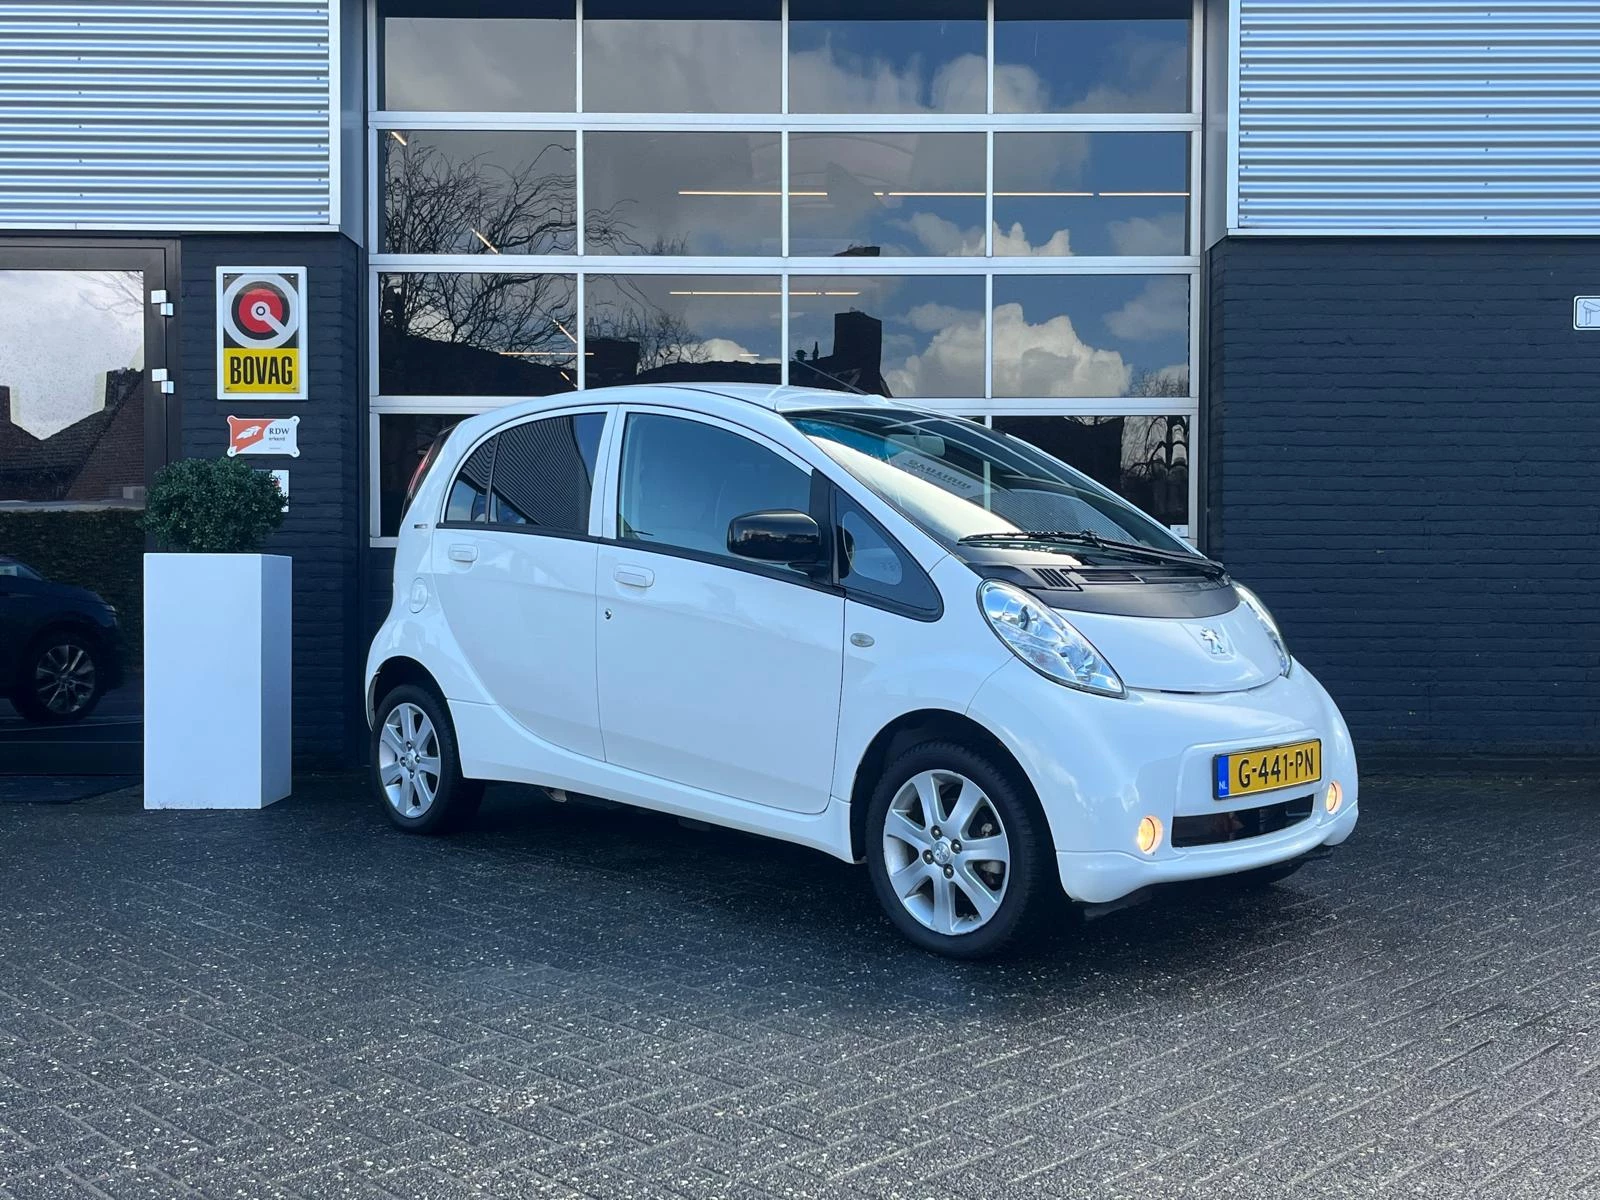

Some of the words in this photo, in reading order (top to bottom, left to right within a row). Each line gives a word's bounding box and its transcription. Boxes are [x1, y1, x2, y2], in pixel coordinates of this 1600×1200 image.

[230, 355, 293, 385] BOVAG
[269, 427, 290, 435] RDW
[1238, 747, 1314, 788] G-441-PN
[1218, 781, 1228, 790] NL
